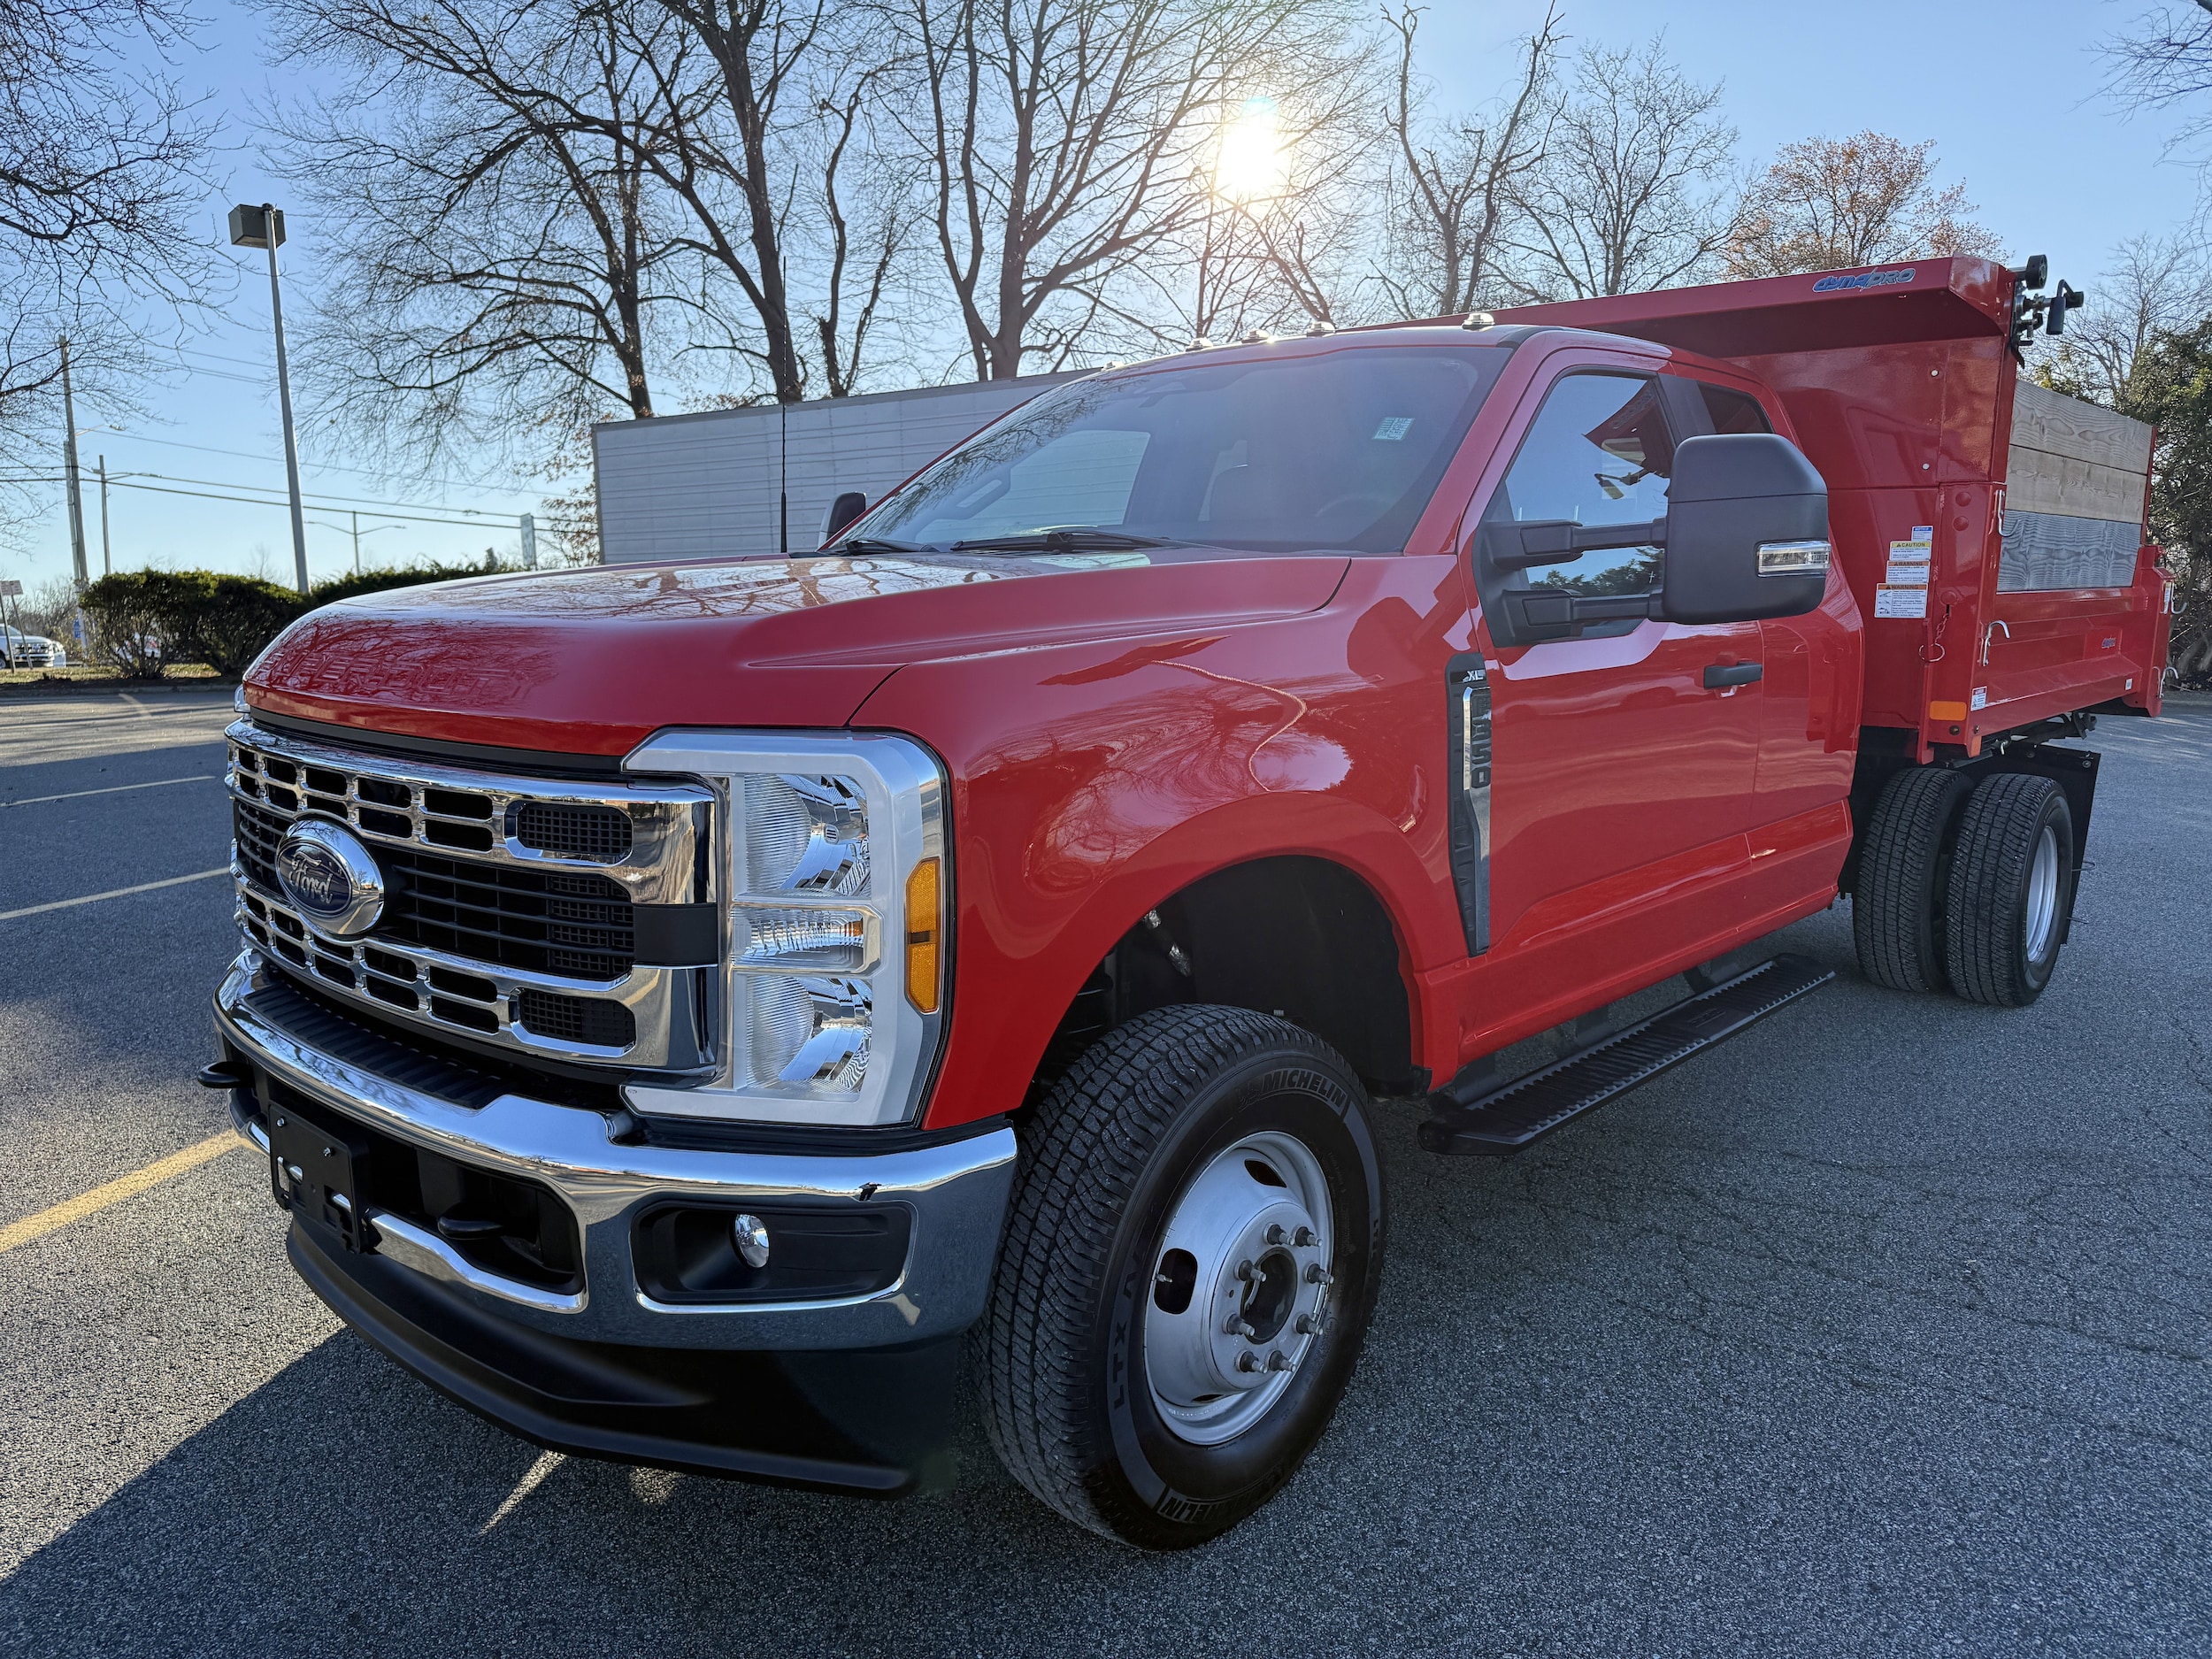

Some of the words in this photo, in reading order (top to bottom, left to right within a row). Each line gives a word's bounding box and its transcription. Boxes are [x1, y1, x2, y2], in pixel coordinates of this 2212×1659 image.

[1467, 670, 1484, 681] XL
[288, 851, 334, 905] Ford
[1263, 1069, 1347, 1108] MICHELIN
[1112, 1320, 1128, 1410] LTX
